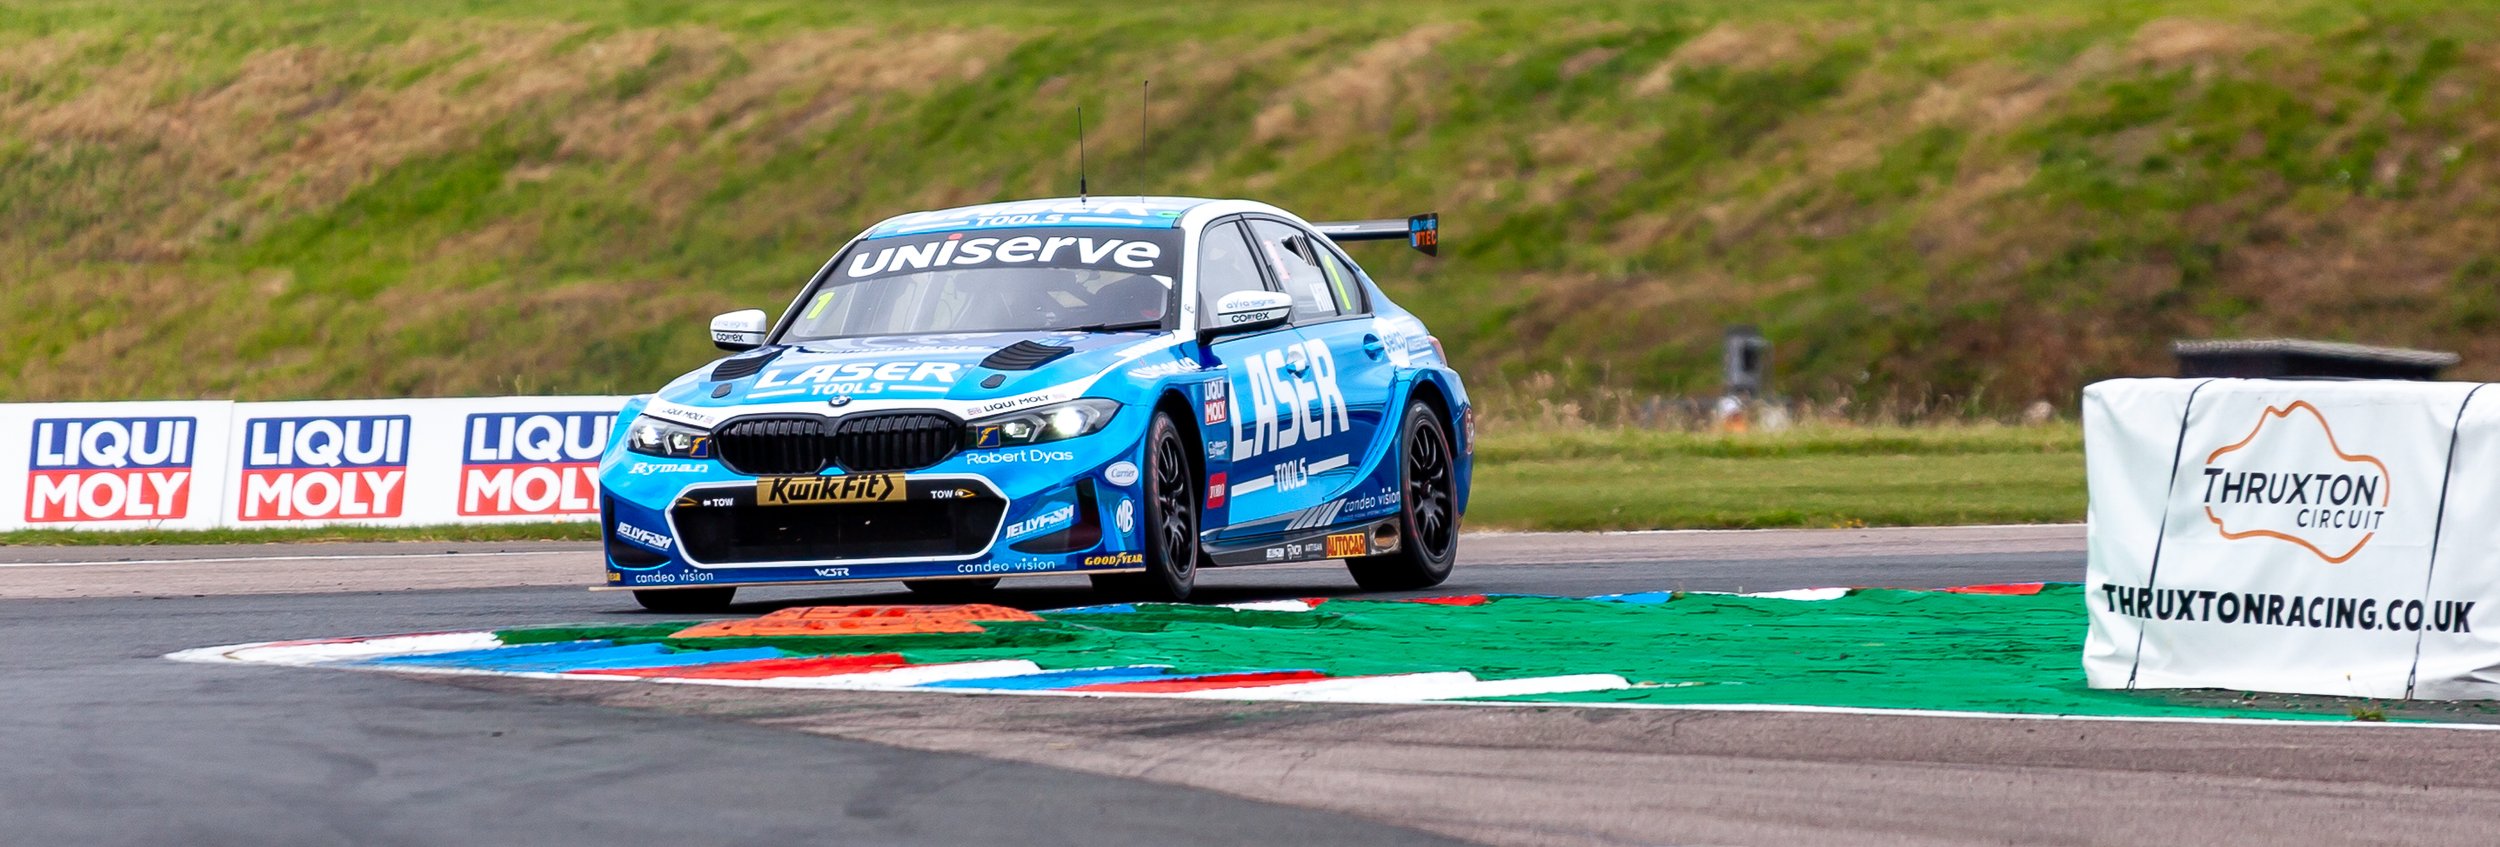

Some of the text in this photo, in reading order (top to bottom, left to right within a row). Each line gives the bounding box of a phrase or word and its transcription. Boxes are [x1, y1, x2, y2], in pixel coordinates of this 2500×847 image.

[975, 213, 1065, 227] TOOLS
[806, 291, 835, 320] 1
[754, 362, 966, 390] LASER
[811, 381, 884, 396] TOOLS
[1204, 379, 1225, 401] LIQUI
[983, 393, 1051, 413] LIQUI MOLY
[1230, 338, 1350, 462] LASER
[1205, 401, 1226, 423] MOLY
[37, 420, 190, 468] LIQUI
[250, 419, 404, 467] LIQUI
[966, 449, 1074, 466] Robert Dyas
[628, 462, 709, 476] Ryman
[1111, 468, 1136, 479] Carrier
[1274, 457, 1308, 493] TOOLS
[32, 470, 190, 519] MOLY
[245, 470, 404, 518] MOLY
[930, 489, 954, 500] TOW
[2203, 467, 2379, 507] THRUXTON
[713, 497, 734, 508] TOW
[1344, 492, 1376, 513] candeo
[1378, 487, 1401, 506] vision
[1005, 504, 1075, 539] JELLYFISH
[2297, 508, 2385, 530] CIRCUIT
[616, 521, 673, 549] JELLYFISH
[1327, 534, 1367, 557] AUTOCAR
[635, 570, 676, 584] candeo
[679, 568, 714, 582] vision
[814, 568, 850, 577] WSR
[957, 556, 1056, 574] candeo vision
[2101, 583, 2476, 635] THRUXTONRACING.CO.UK
